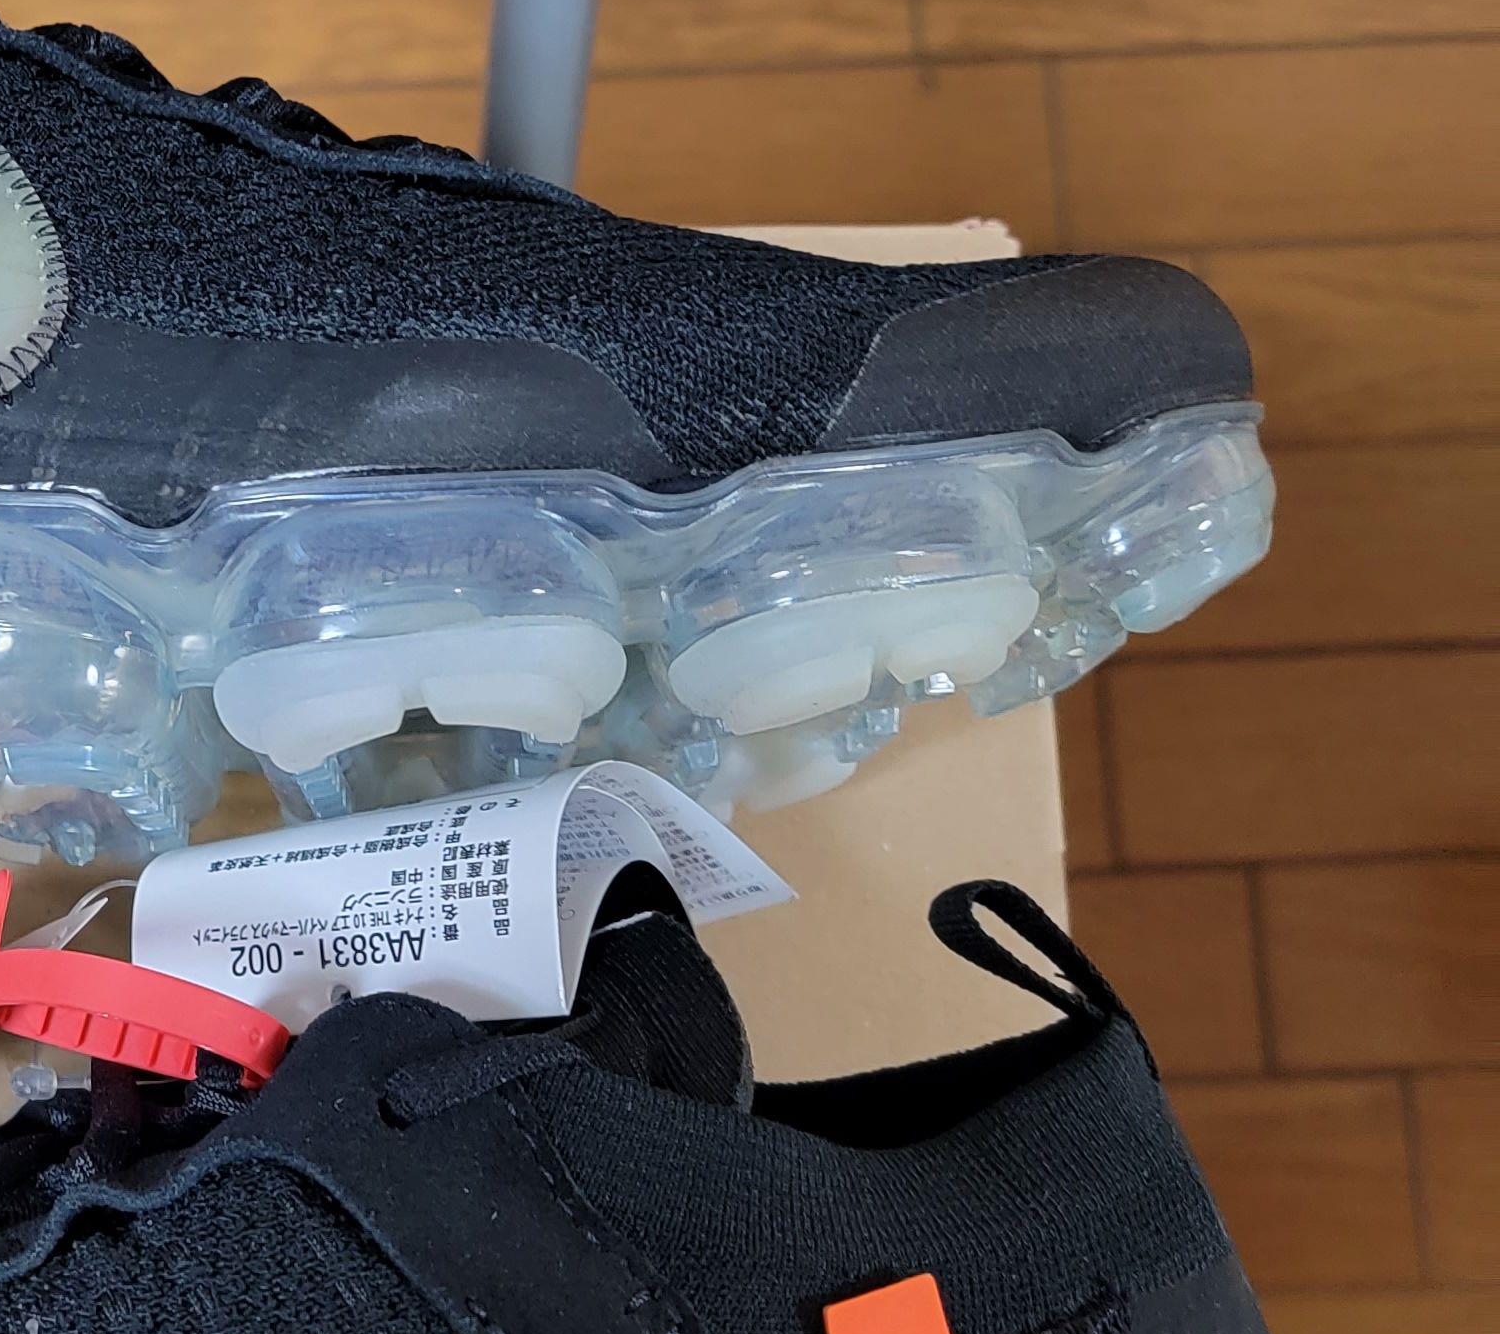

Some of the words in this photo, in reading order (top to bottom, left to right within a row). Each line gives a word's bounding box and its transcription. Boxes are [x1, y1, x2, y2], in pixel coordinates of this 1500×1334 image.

[441, 838, 510, 860] 素材表記
[352, 912, 365, 927] 10
[367, 909, 390, 925] THE
[229, 941, 281, 976] 002
[317, 927, 425, 969] AA3831
